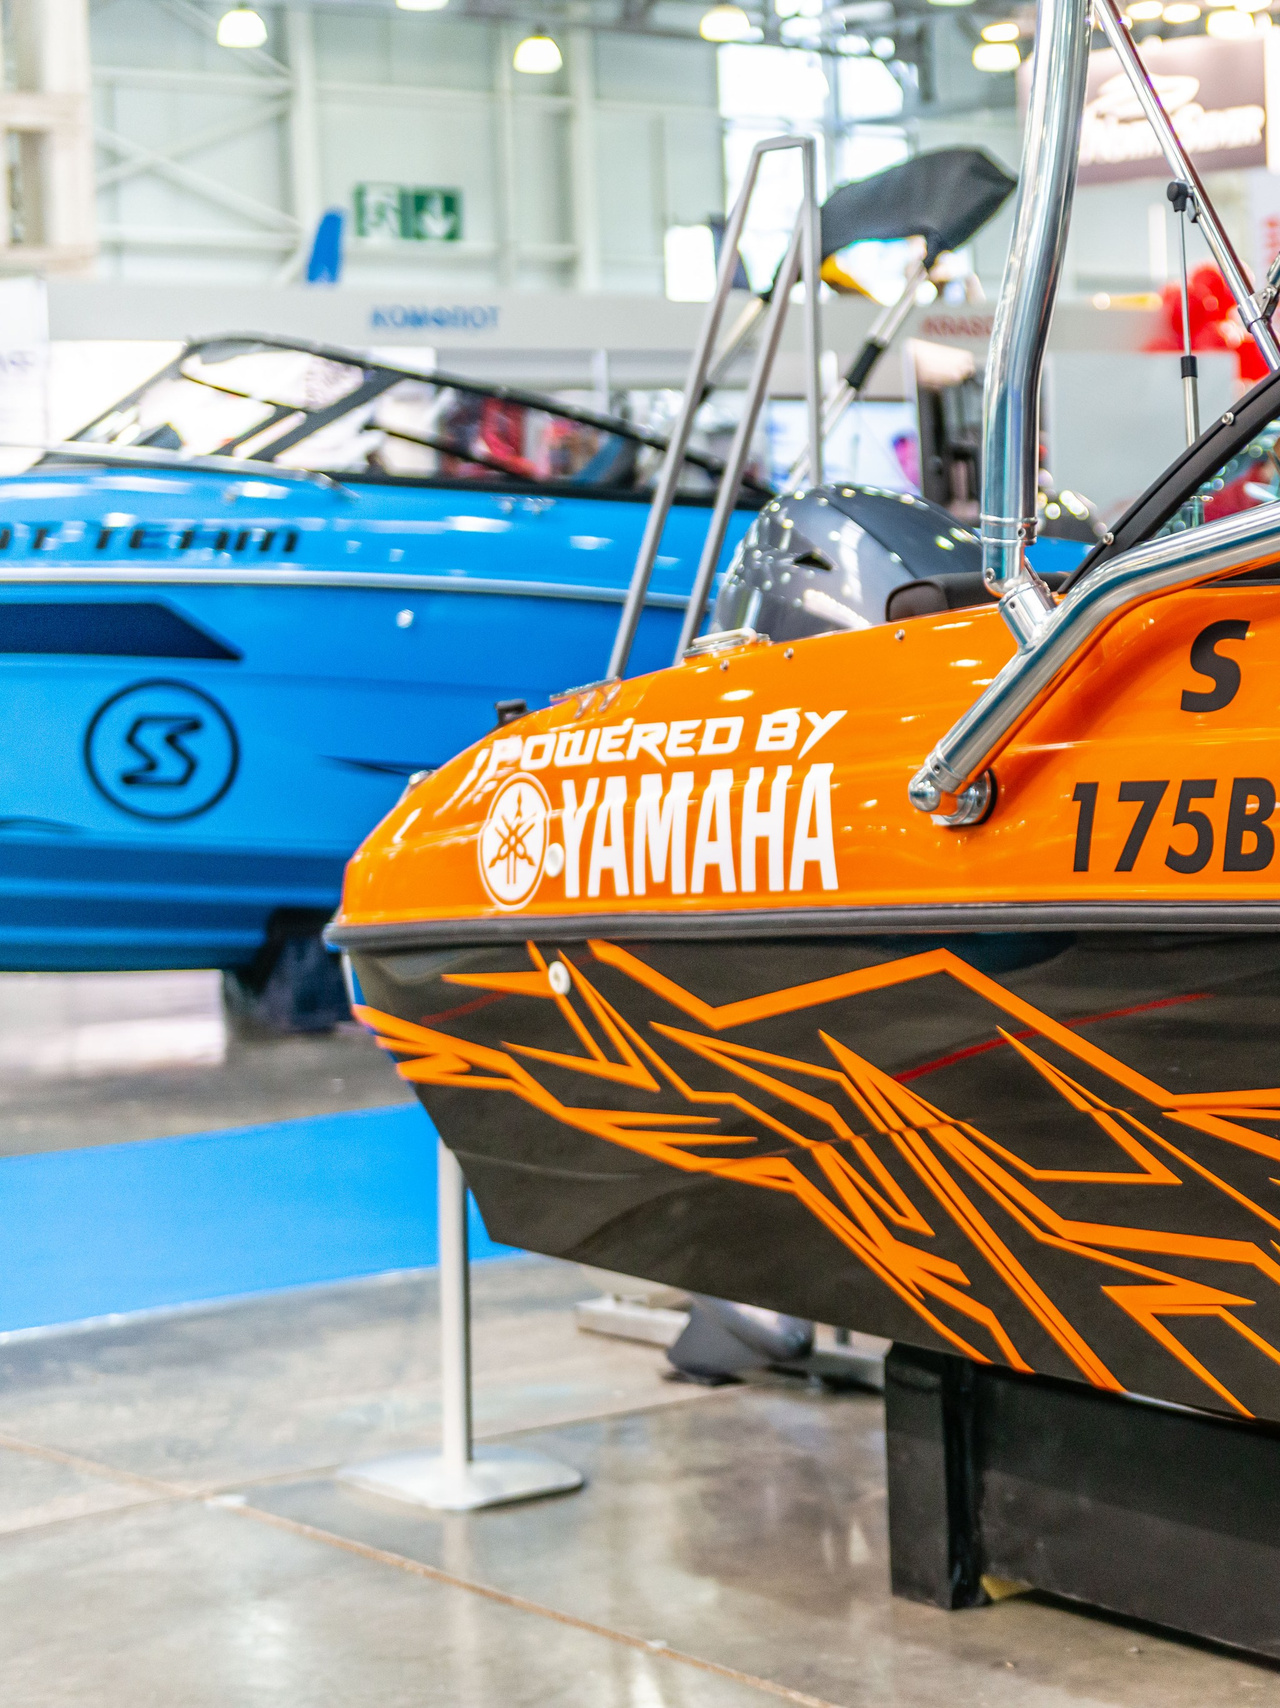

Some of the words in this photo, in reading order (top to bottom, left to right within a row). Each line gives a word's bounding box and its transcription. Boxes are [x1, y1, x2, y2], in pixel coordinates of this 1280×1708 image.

[482, 716, 745, 780] POWERED
[755, 709, 848, 760] BY
[561, 762, 839, 899] YAMAHA
